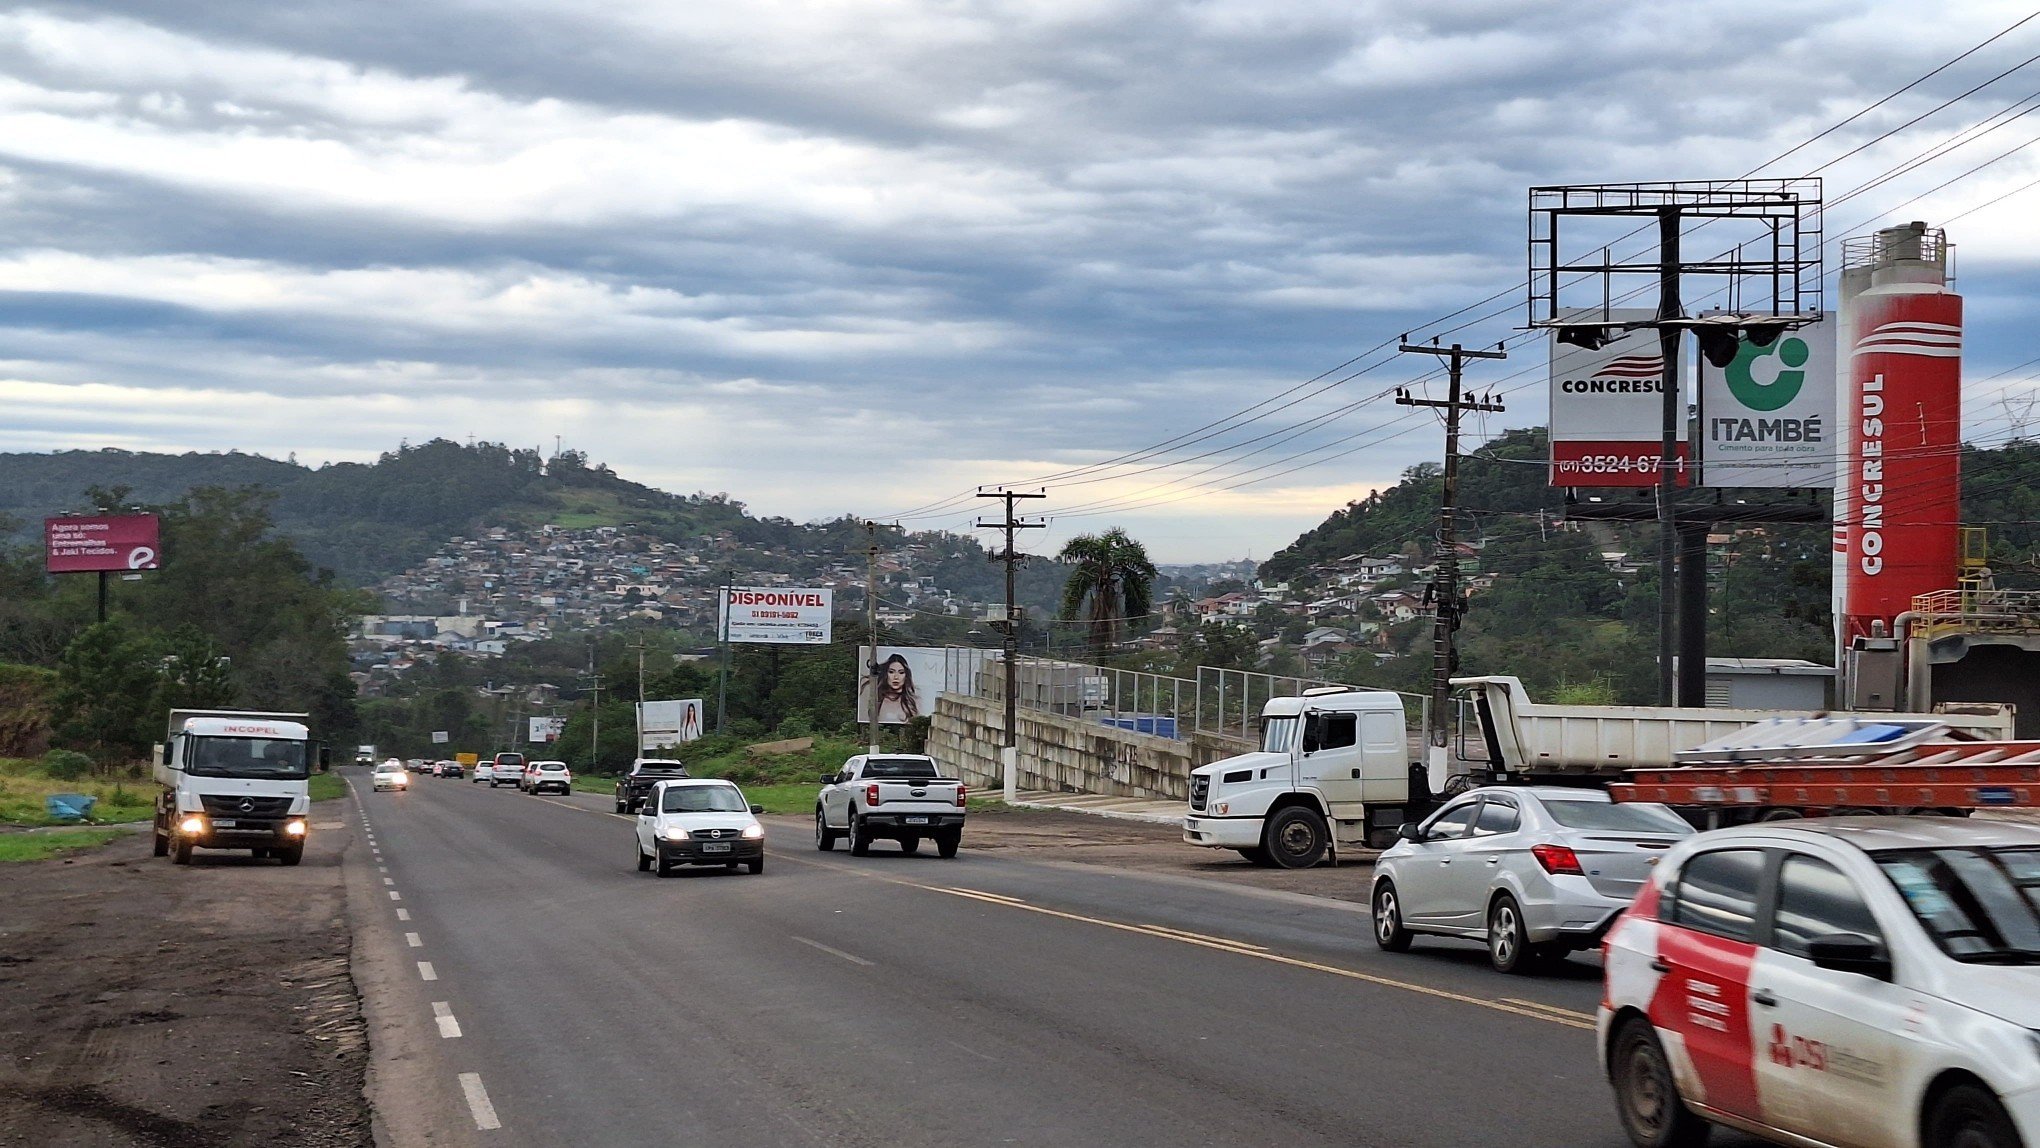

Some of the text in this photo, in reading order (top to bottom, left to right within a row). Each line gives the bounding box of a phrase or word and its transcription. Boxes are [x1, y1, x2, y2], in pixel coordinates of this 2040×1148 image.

[1562, 380, 1680, 393] CONCRESU
[1712, 414, 1821, 442] ITAMBÉ
[1718, 444, 1753, 452] Cimento
[1796, 444, 1815, 452] obra
[1861, 374, 1884, 575] CONCRESUL
[52, 524, 79, 532] Agora
[730, 591, 824, 607] DISPONÍVEL
[224, 726, 280, 735] INCOPEL
